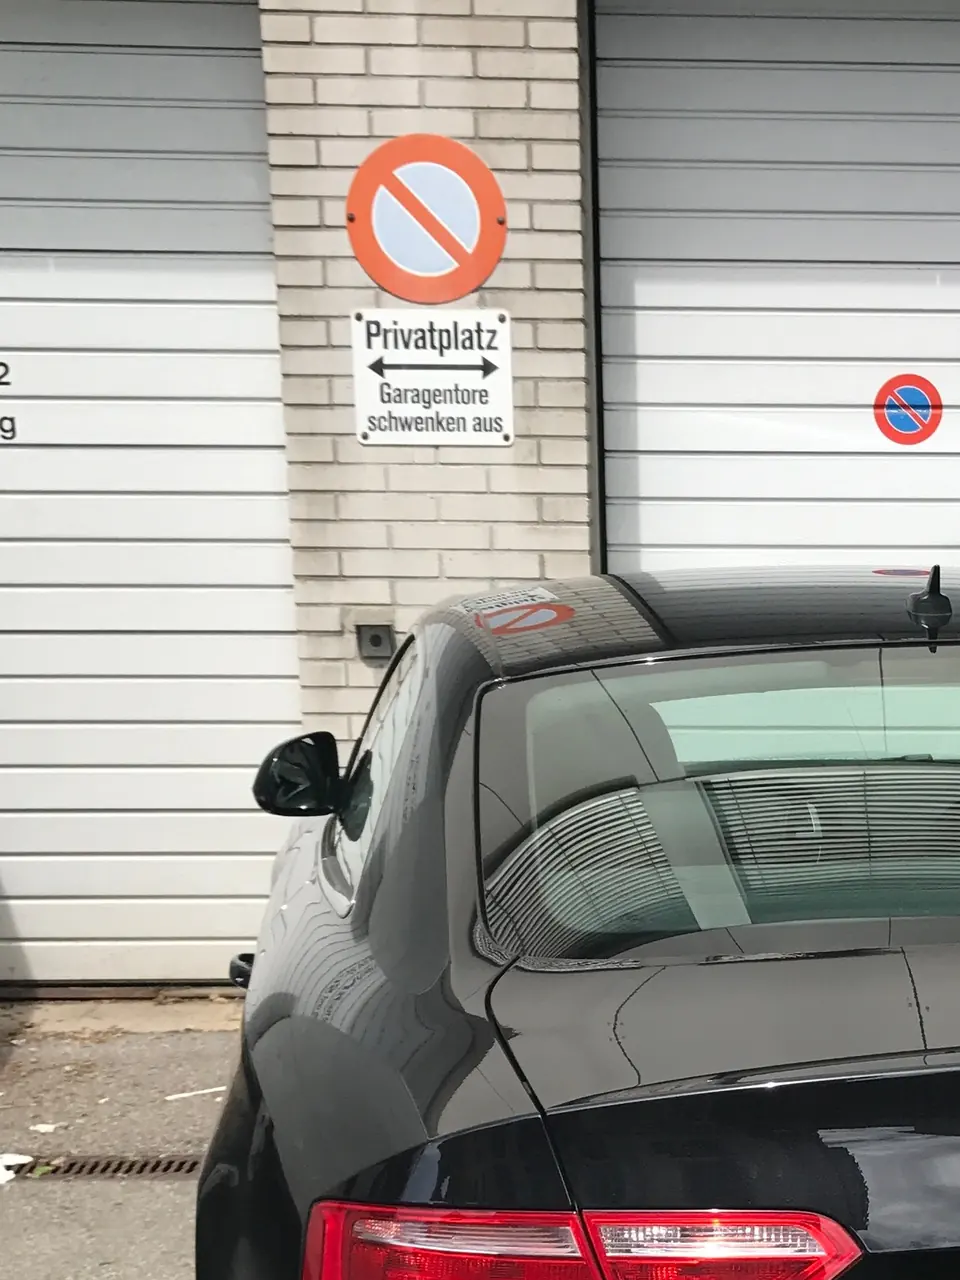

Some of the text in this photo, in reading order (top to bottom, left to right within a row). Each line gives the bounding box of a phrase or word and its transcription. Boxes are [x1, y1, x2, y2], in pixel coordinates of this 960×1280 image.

[366, 320, 499, 357] Privatplatz
[380, 382, 488, 409] Garagentore
[367, 411, 504, 433] schwenken aus
